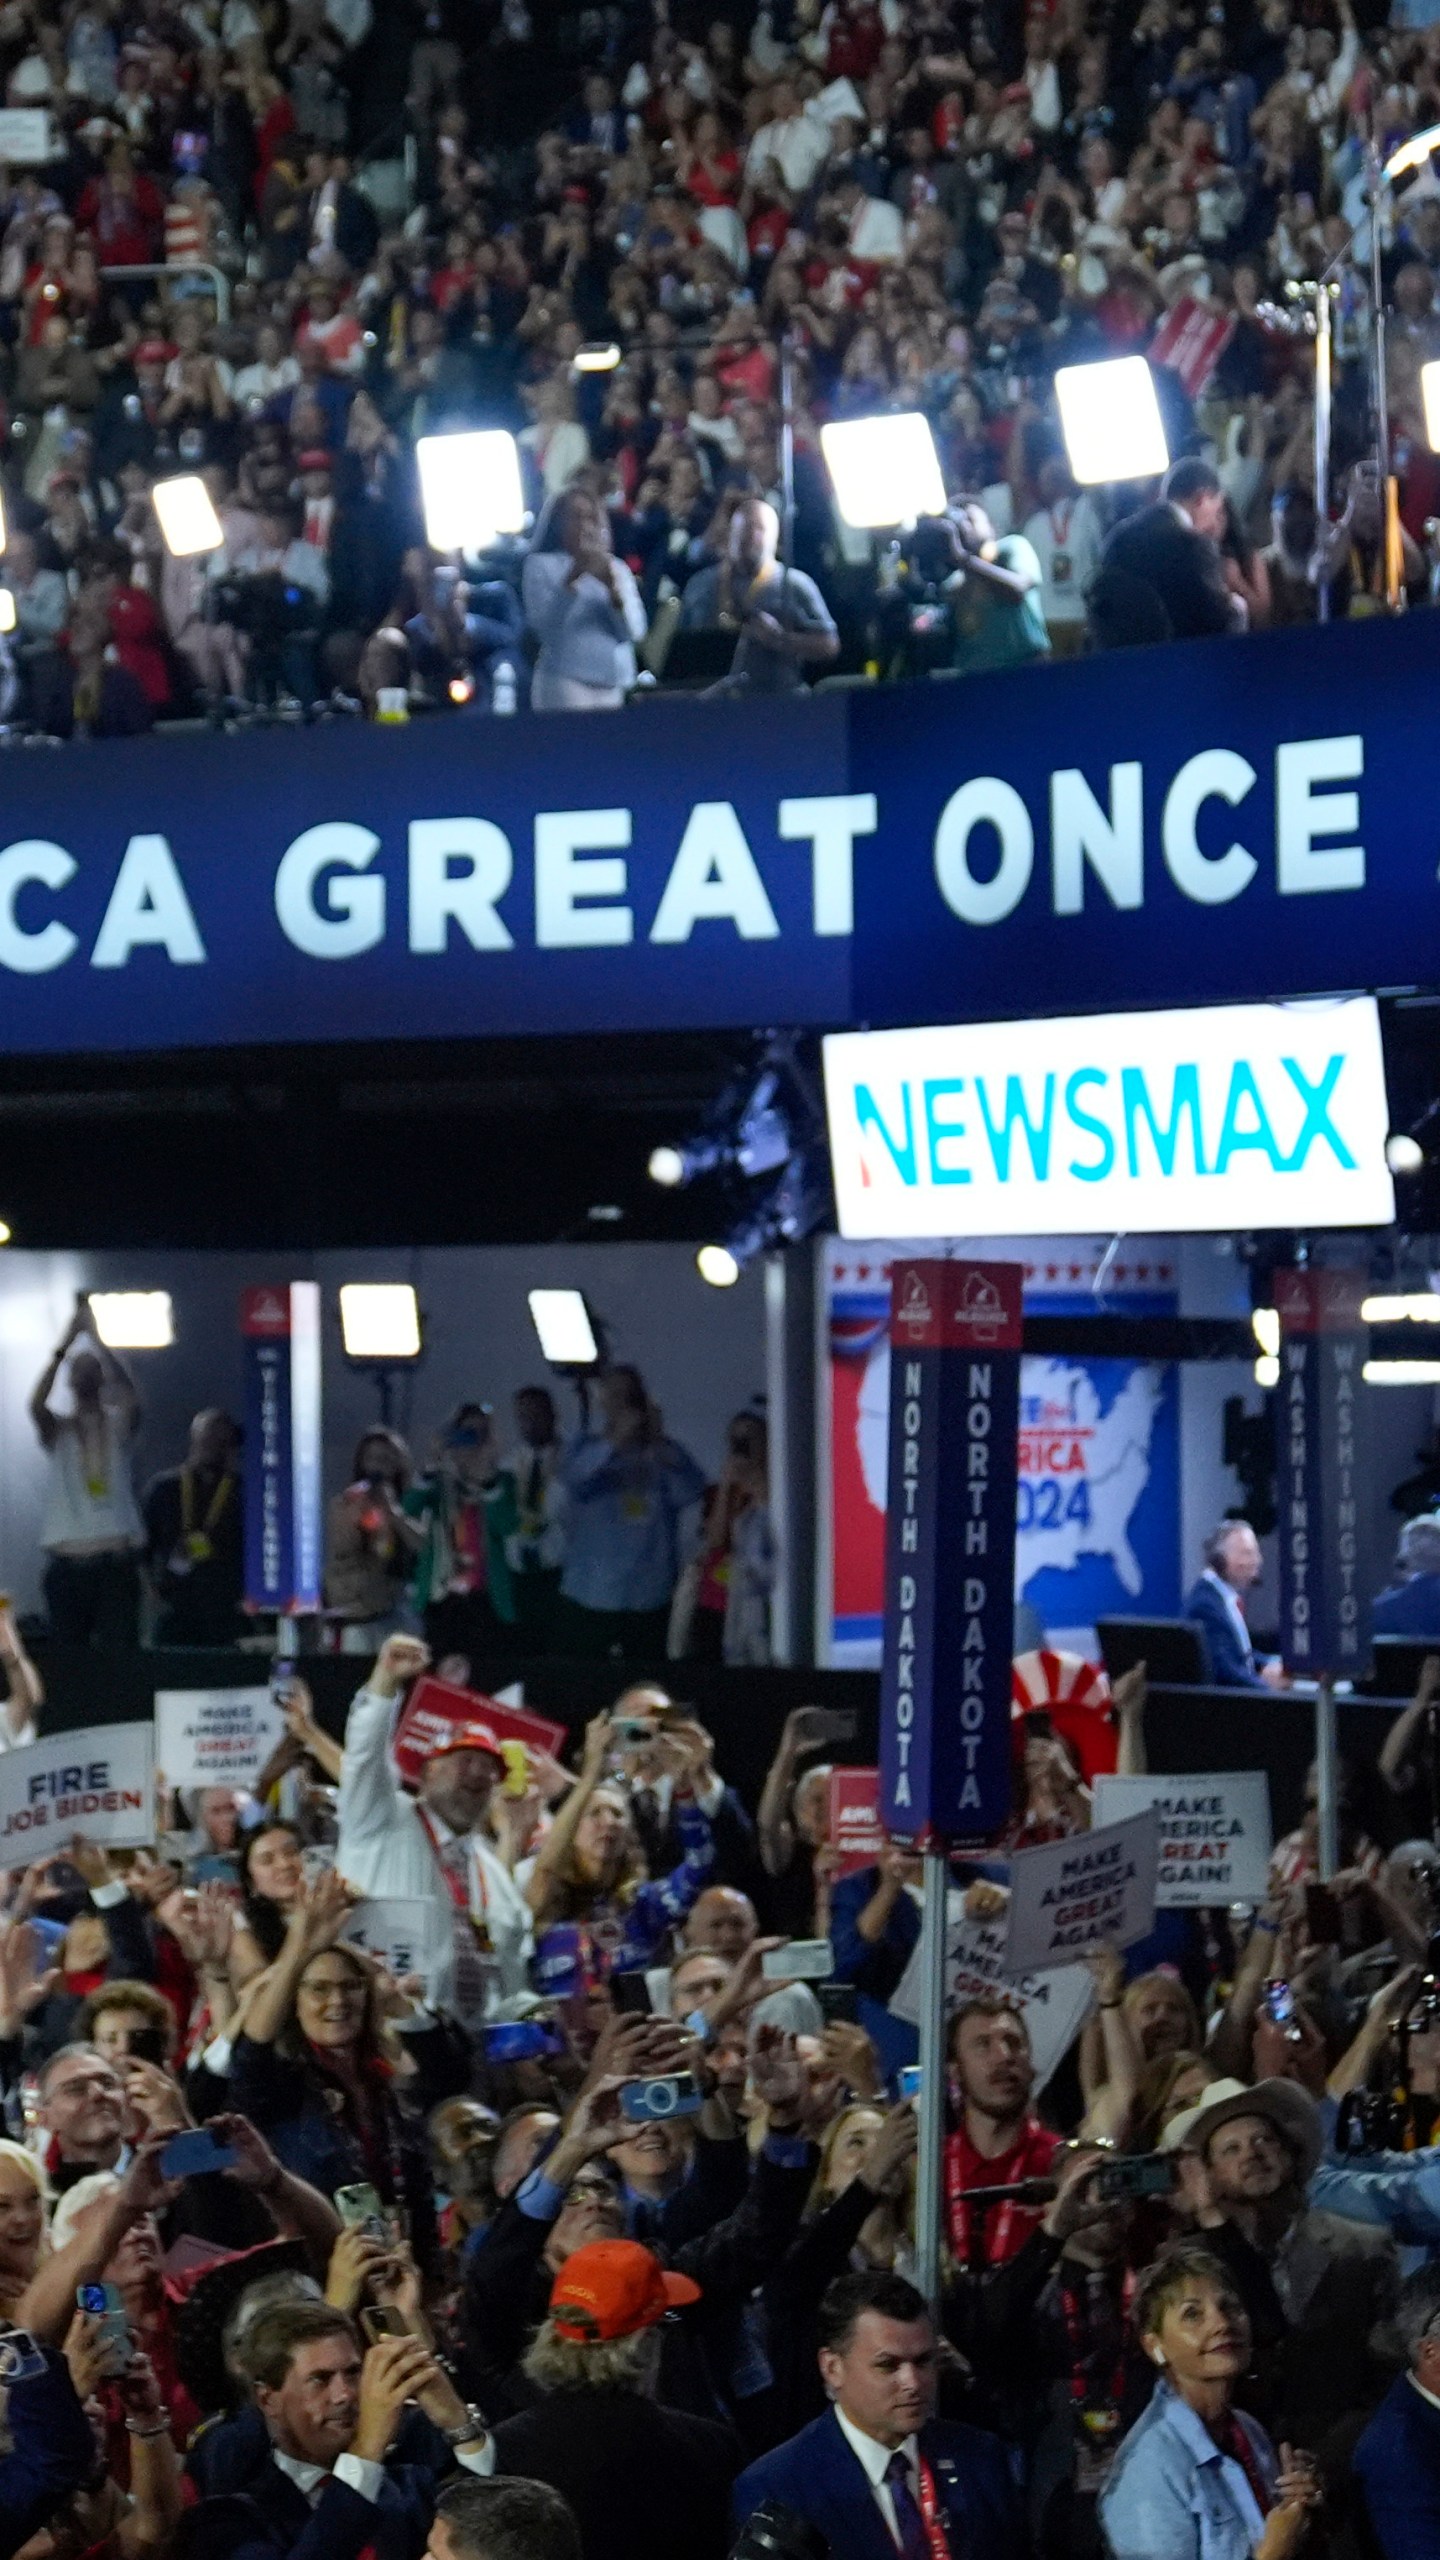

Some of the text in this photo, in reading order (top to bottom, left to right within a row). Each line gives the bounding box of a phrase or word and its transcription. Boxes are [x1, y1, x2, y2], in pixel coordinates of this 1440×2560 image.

[275, 793, 878, 957] GREAT
[934, 735, 1365, 925] ONCE
[854, 1053, 1361, 1187] NEWSMAX
[966, 1363, 992, 1556] NORTH
[1017, 1441, 1086, 1473] RICA
[1285, 1343, 1311, 1656] WASHINGTON
[1334, 1343, 1360, 1656] WASHINGTON
[894, 1362, 922, 1807] NORTH DAKOTA
[958, 1578, 988, 1809] DAKOTA
[28, 1761, 110, 1804] FIRE
[3, 1789, 142, 1836] JOE BIDEN
[1157, 1817, 1245, 1839] ERICA
[1061, 1841, 1123, 1877] MAKE
[1158, 1862, 1233, 1884] GAIN!
[1162, 1841, 1229, 1860] REAT
[1040, 1860, 1137, 1909] AMERICA
[1053, 1886, 1125, 1927] GREAT
